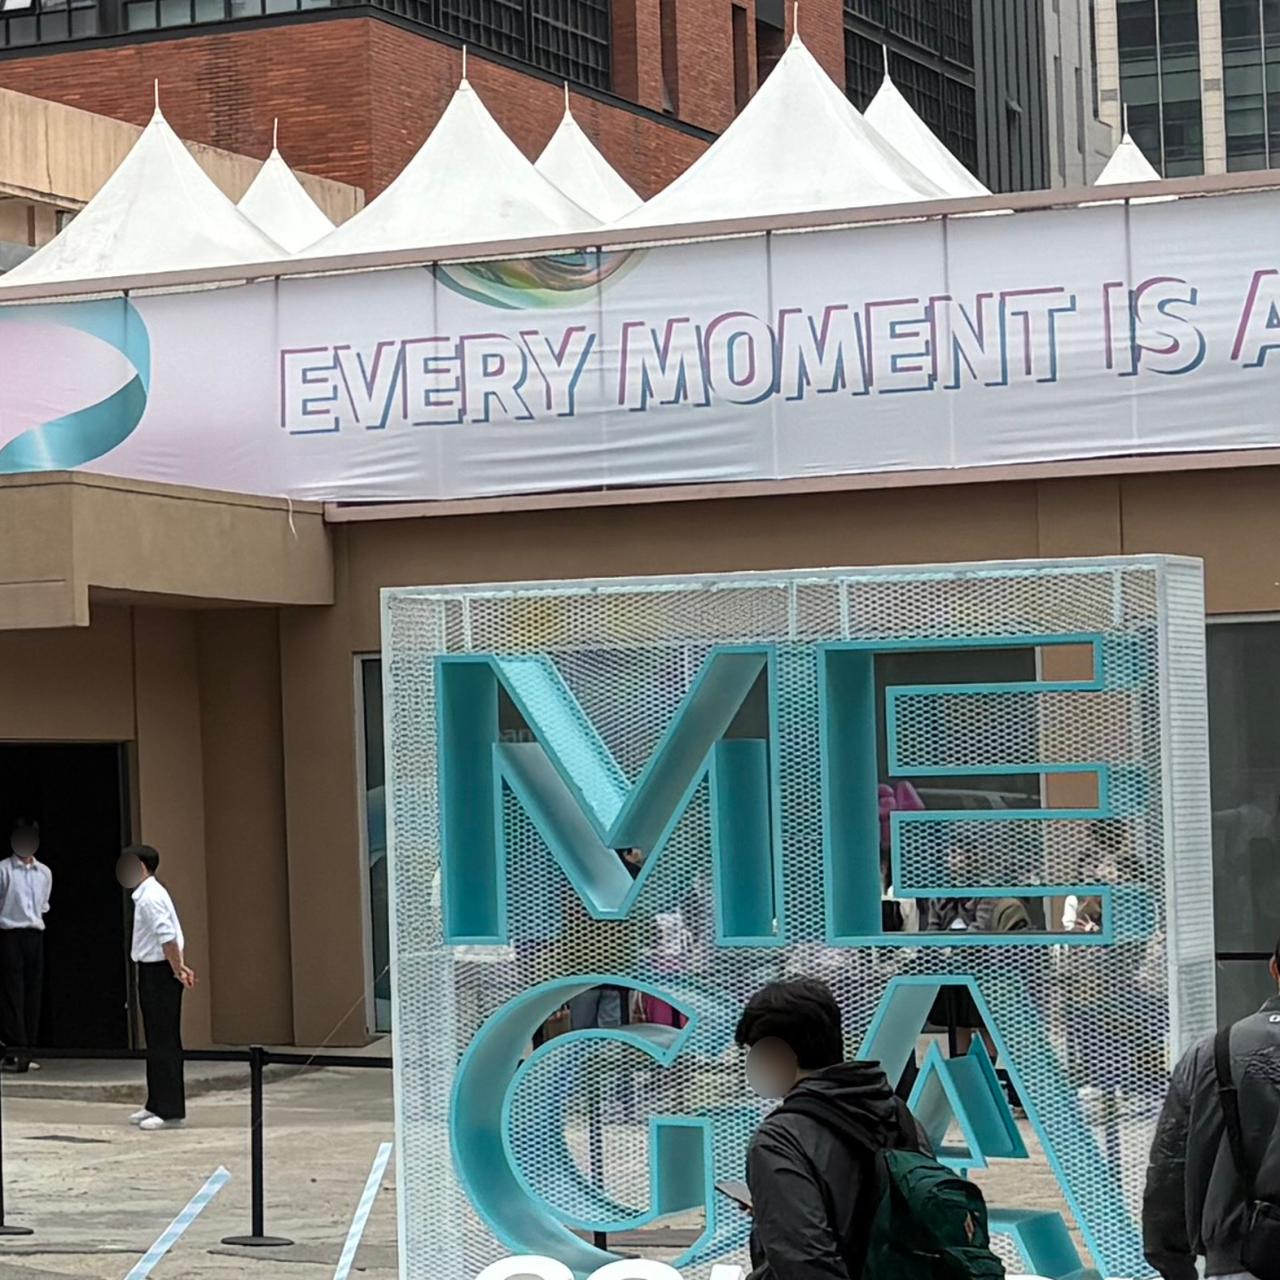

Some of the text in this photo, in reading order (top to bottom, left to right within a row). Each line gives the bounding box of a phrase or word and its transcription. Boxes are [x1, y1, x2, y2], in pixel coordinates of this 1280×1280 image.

[280, 325, 596, 435] EVERY
[618, 287, 1076, 412] MOMENT
[1103, 276, 1206, 377] IS
